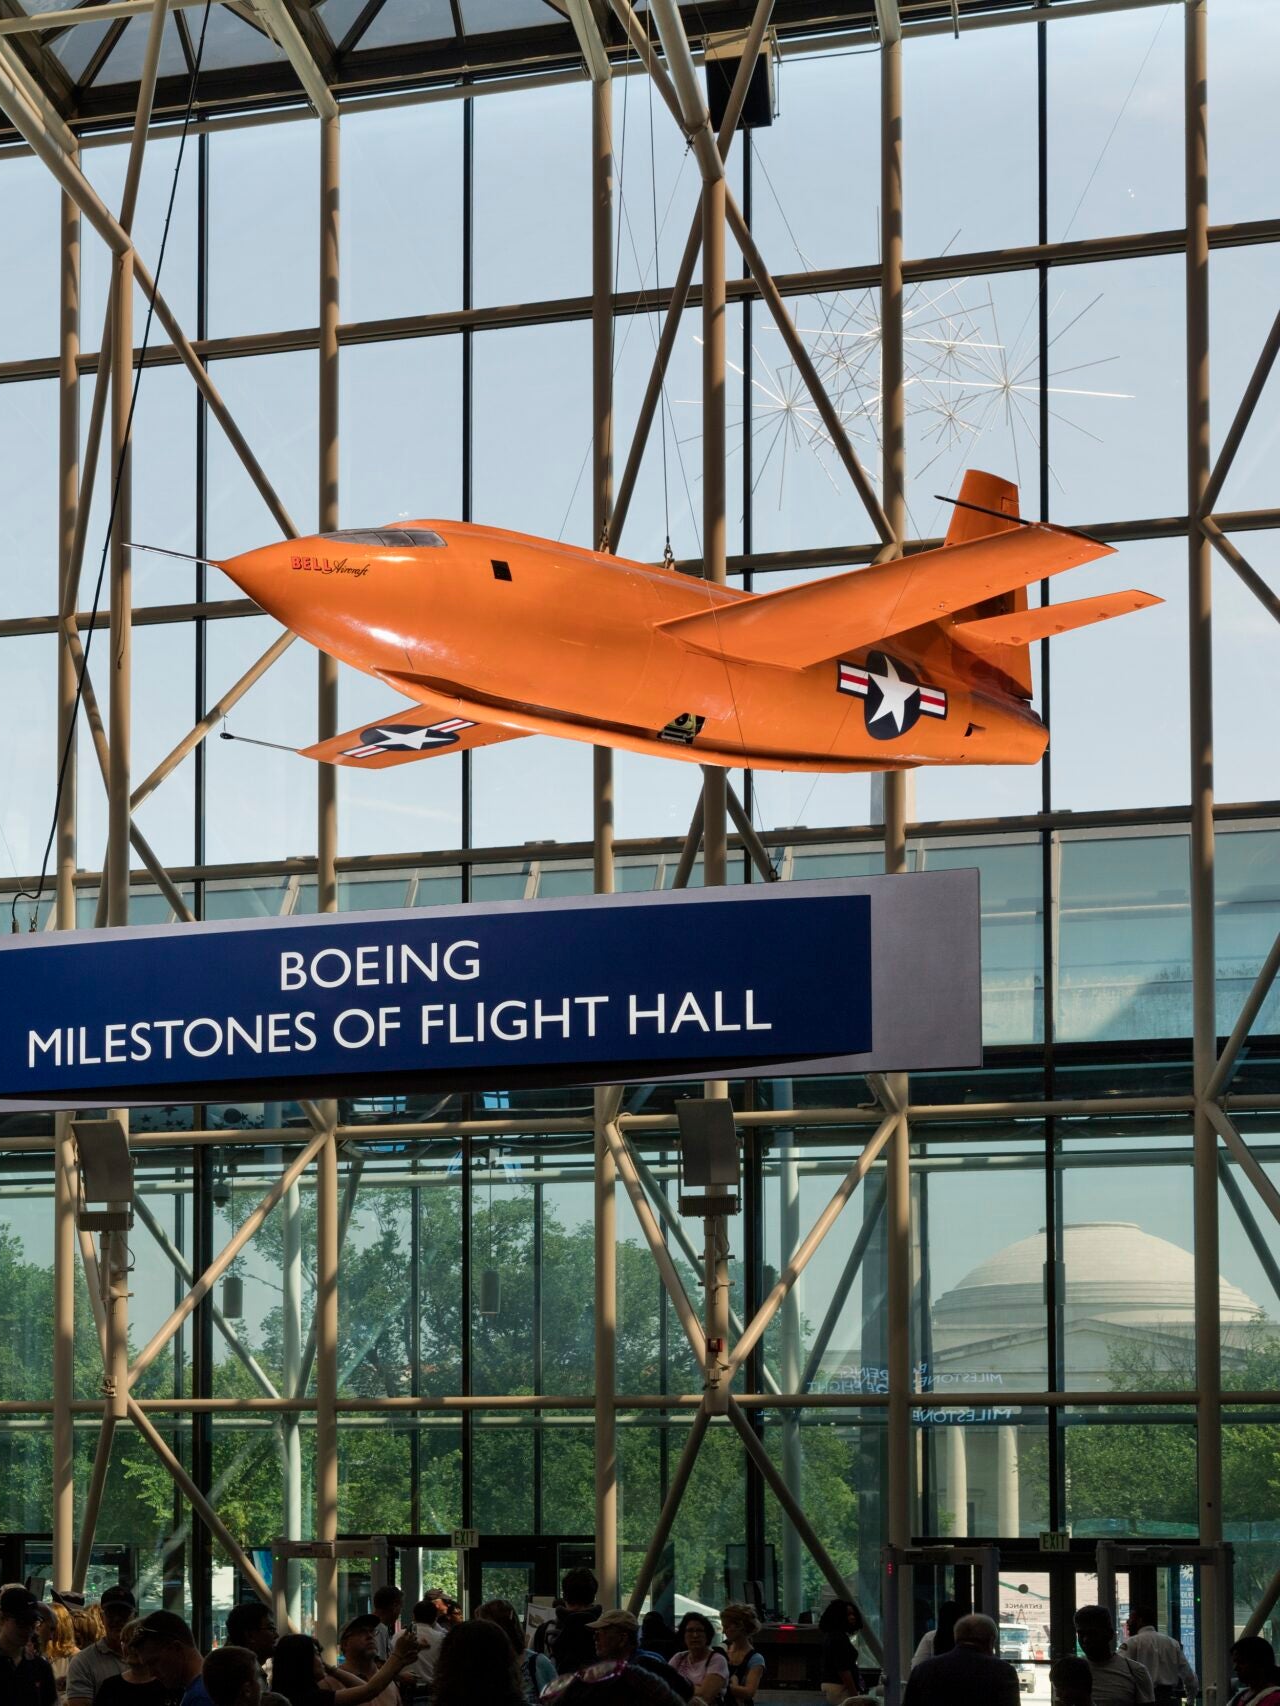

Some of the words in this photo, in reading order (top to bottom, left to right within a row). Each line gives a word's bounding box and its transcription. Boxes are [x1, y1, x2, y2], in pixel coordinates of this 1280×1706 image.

[291, 556, 332, 572] BELL
[322, 558, 370, 578] Aircraft
[280, 940, 481, 991] BOEING
[28, 1011, 318, 1068] MILESTONES
[333, 1006, 401, 1049] OF
[421, 995, 609, 1045] FLIGHT
[629, 989, 772, 1036] HALL
[454, 1530, 476, 1546] EXIT
[1042, 1534, 1066, 1549] EXIT
